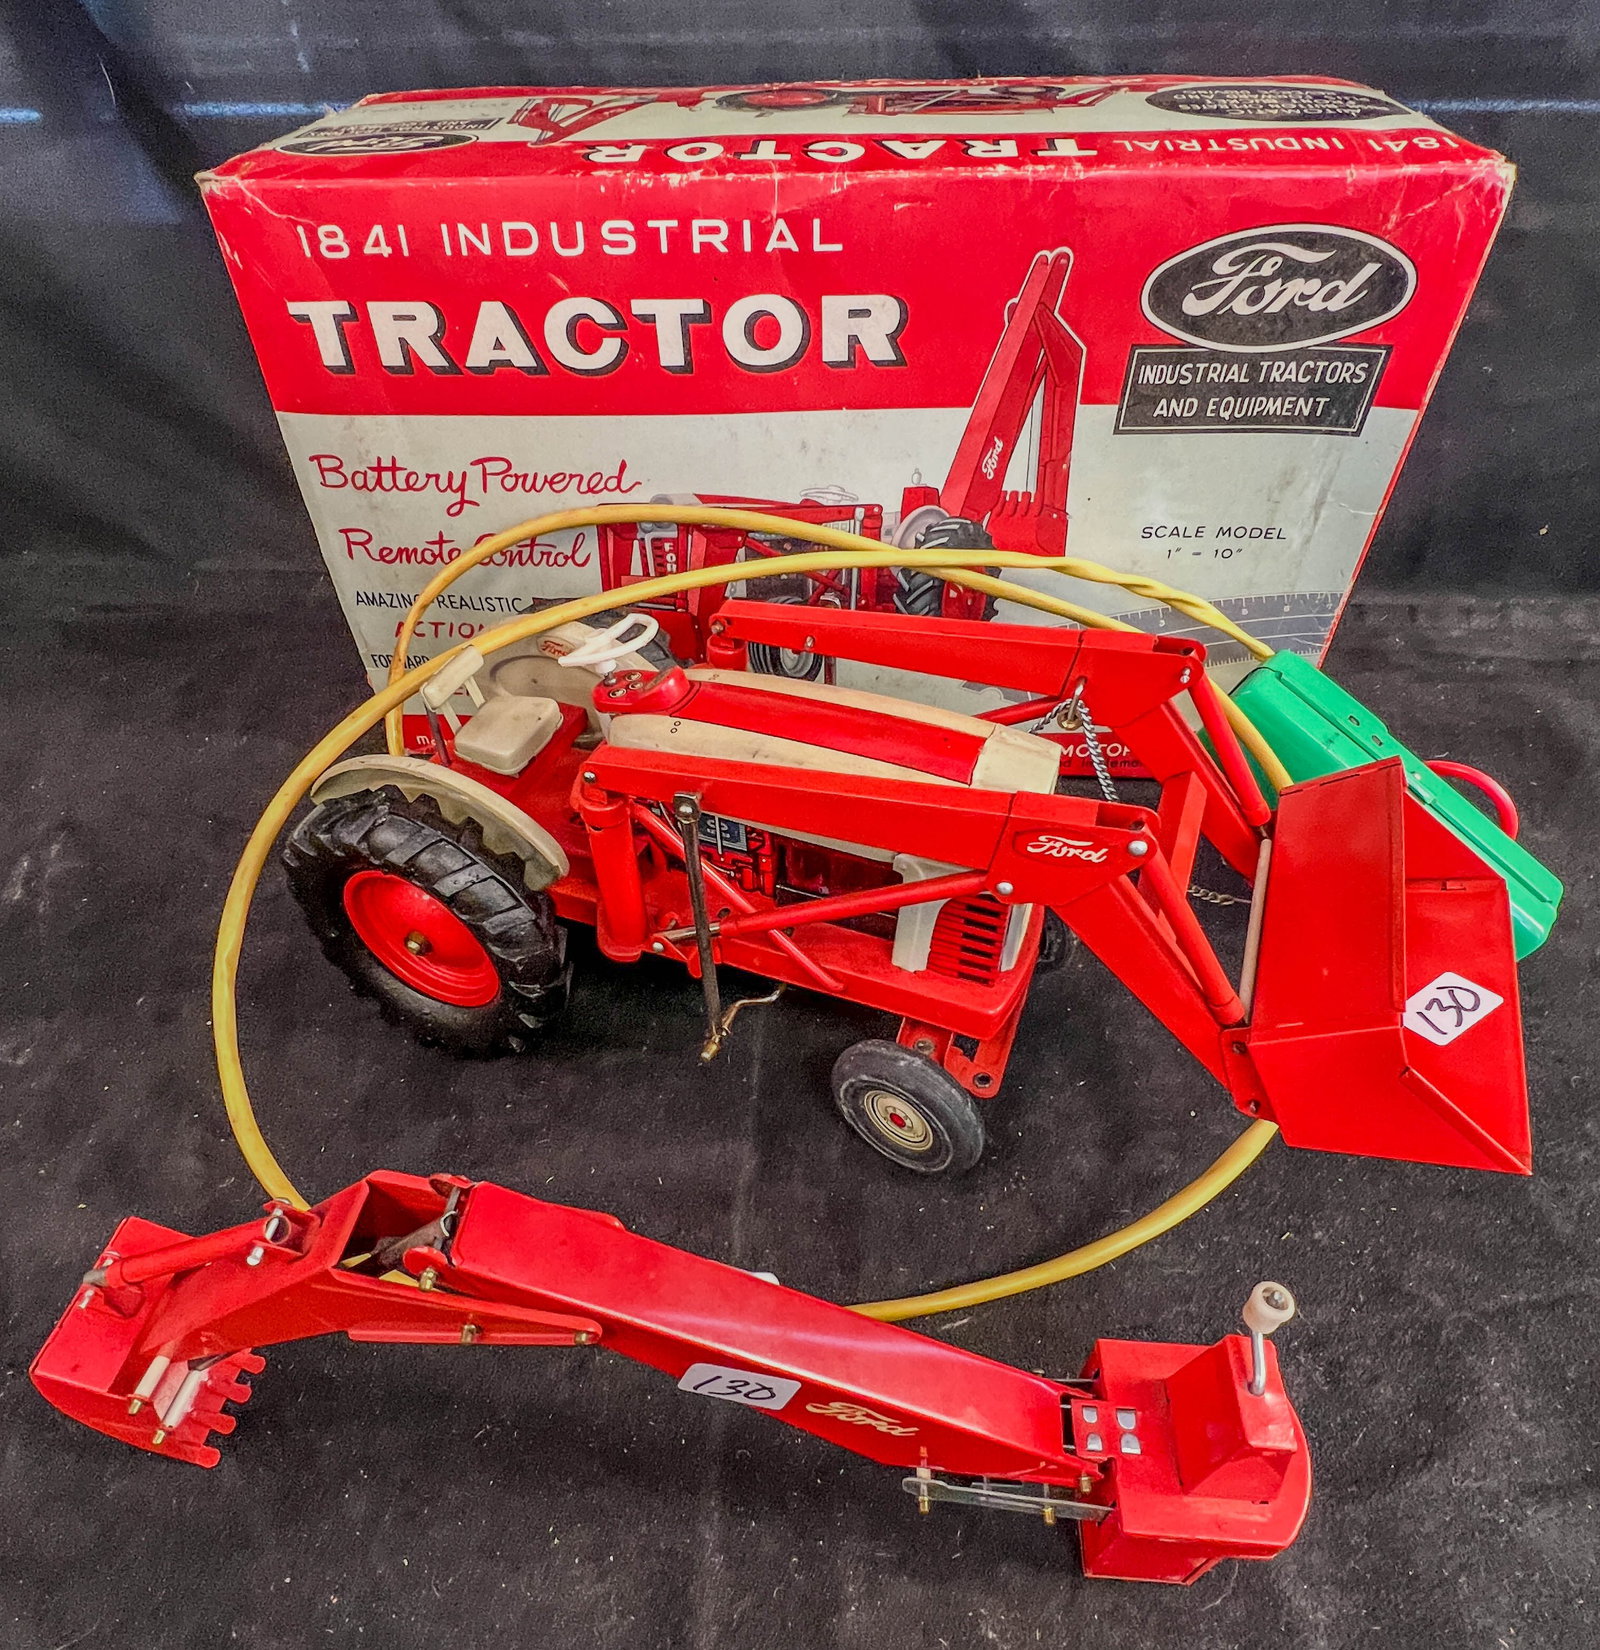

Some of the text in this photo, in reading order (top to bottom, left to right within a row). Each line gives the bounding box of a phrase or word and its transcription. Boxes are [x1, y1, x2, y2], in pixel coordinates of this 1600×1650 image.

[306, 135, 445, 152] Ford
[582, 136, 1459, 163] 1841 INDUSTRIAL TRACTOR
[296, 217, 844, 259] 1841 INDUSTRIAL
[1181, 241, 1383, 317] Ford
[288, 293, 909, 377] TRACTOR
[1137, 359, 1368, 385] INDUSTRIAL TRACTORS
[1152, 396, 1330, 418] AND EQUIPMENT
[981, 436, 1004, 480] Ford
[308, 453, 643, 517] Battery Powered
[338, 528, 463, 566] Remote
[1140, 525, 1287, 540] SCALE MODEL
[437, 594, 523, 613] REALISTIC
[1026, 834, 1108, 864] Ford
[1417, 985, 1481, 1036] 130
[692, 1375, 777, 1401] 130
[805, 1401, 920, 1437] Ford
